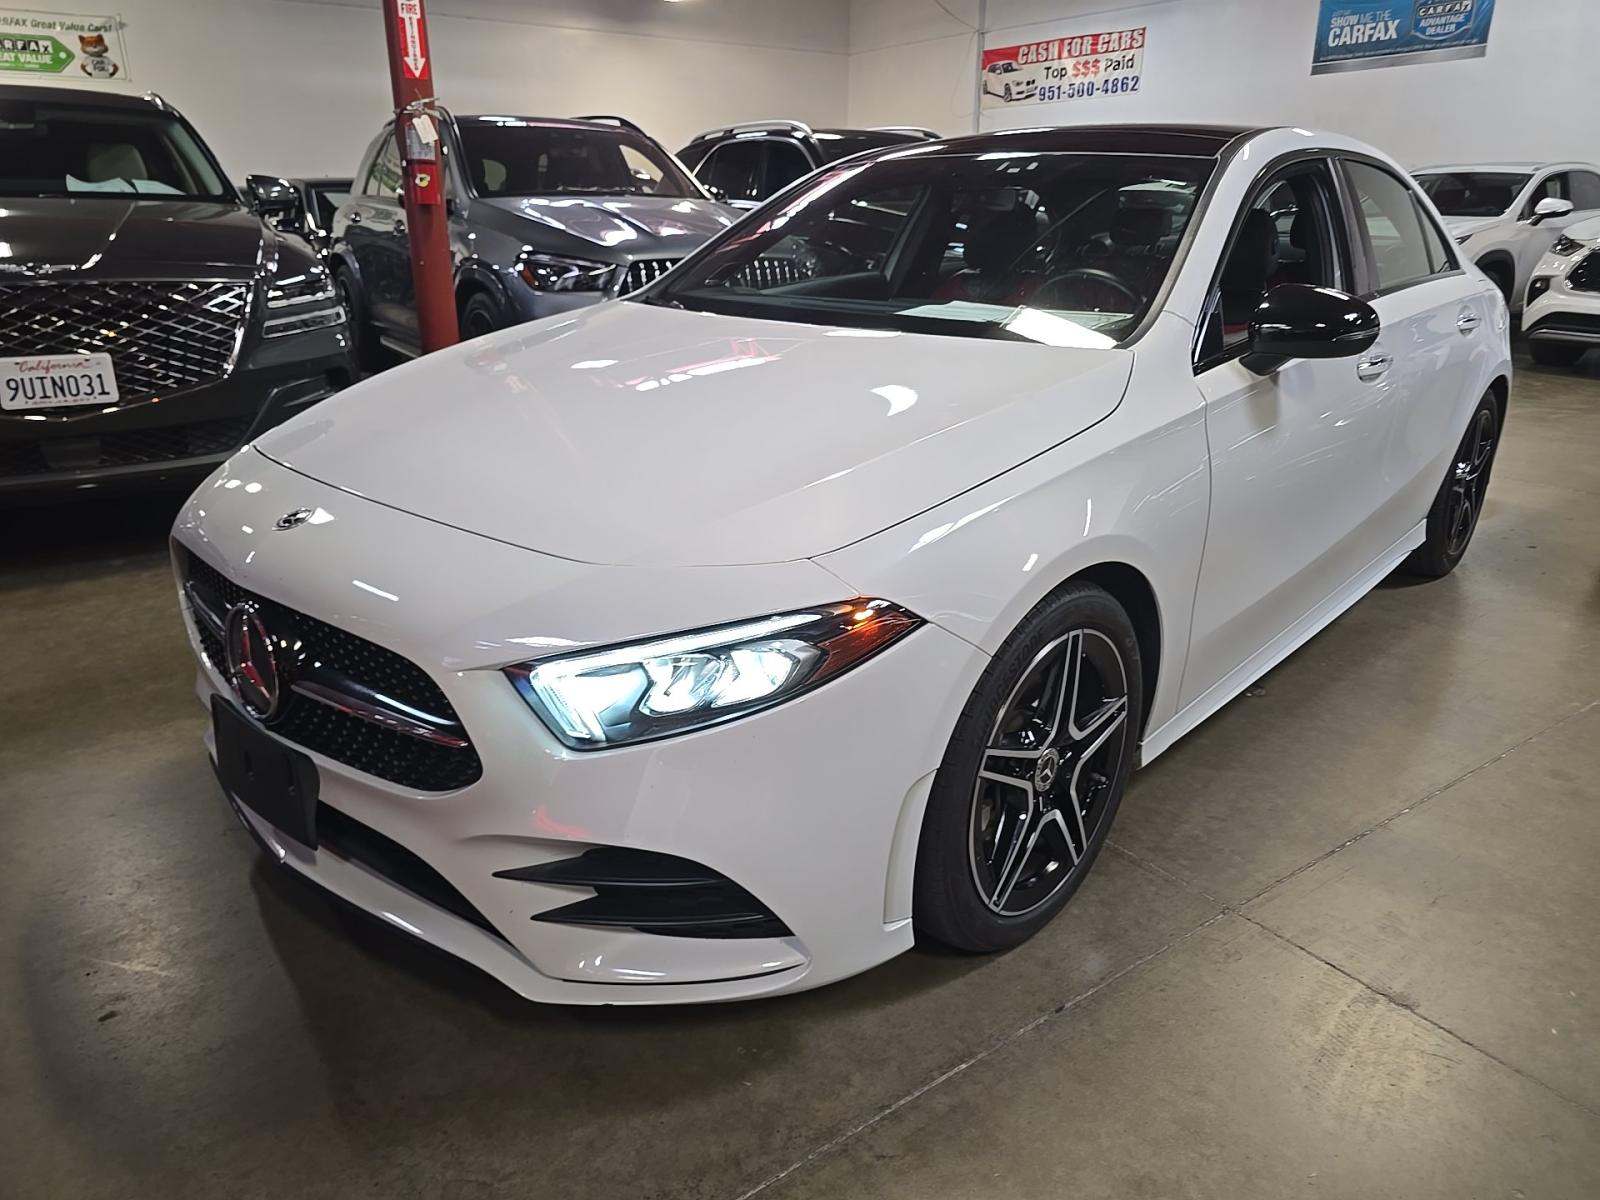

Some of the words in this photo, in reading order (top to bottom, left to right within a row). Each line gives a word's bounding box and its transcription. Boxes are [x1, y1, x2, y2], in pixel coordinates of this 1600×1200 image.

[1419, 1, 1473, 17] CARFAX
[31, 19, 56, 30] Great
[60, 22, 86, 32] Value
[1330, 15, 1360, 28] SHOW
[1360, 12, 1376, 23] ME
[1378, 9, 1393, 22] THE
[1419, 13, 1467, 28] ADVANTAGE
[1328, 20, 1400, 47] CARFAX
[1425, 24, 1456, 36] DEALER
[1018, 39, 1059, 65] CASH
[1061, 36, 1093, 60] FOR
[1097, 29, 1145, 54] CARS
[18, 53, 53, 64] VALUE
[1044, 66, 1067, 80] Top
[1072, 58, 1101, 78] $$$
[1105, 54, 1136, 71] Paid
[1038, 76, 1140, 101] 951-500-4862
[19, 360, 91, 373] California
[6, 373, 110, 402] 9UIN031
